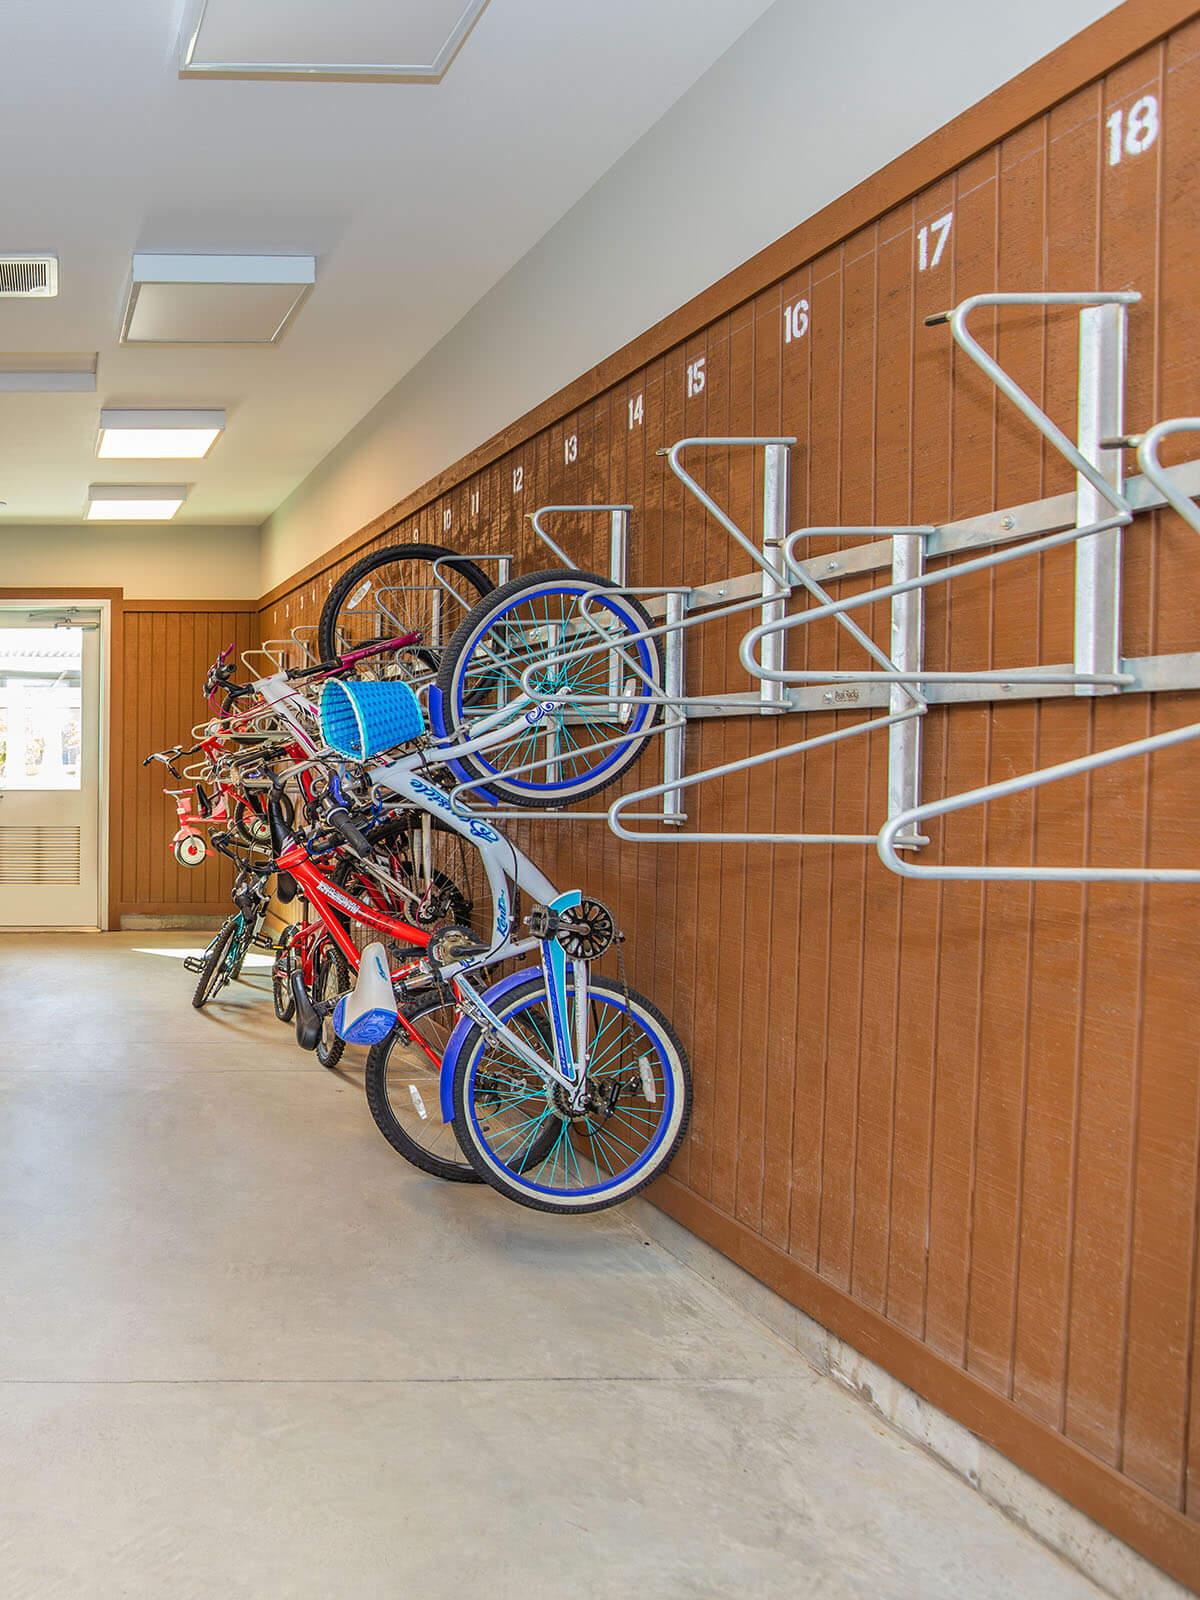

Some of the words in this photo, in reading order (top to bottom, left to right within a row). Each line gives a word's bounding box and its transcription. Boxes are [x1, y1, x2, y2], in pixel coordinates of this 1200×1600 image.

[1106, 95, 1158, 166] 18
[917, 212, 953, 272] 17
[784, 300, 808, 343] 16
[687, 358, 705, 398] 15
[628, 394, 643, 430] 14
[564, 435, 578, 464] 13
[513, 466, 523, 493] 12
[443, 508, 451, 531] 10
[472, 491, 479, 516] 11
[413, 528, 419, 544] 9
